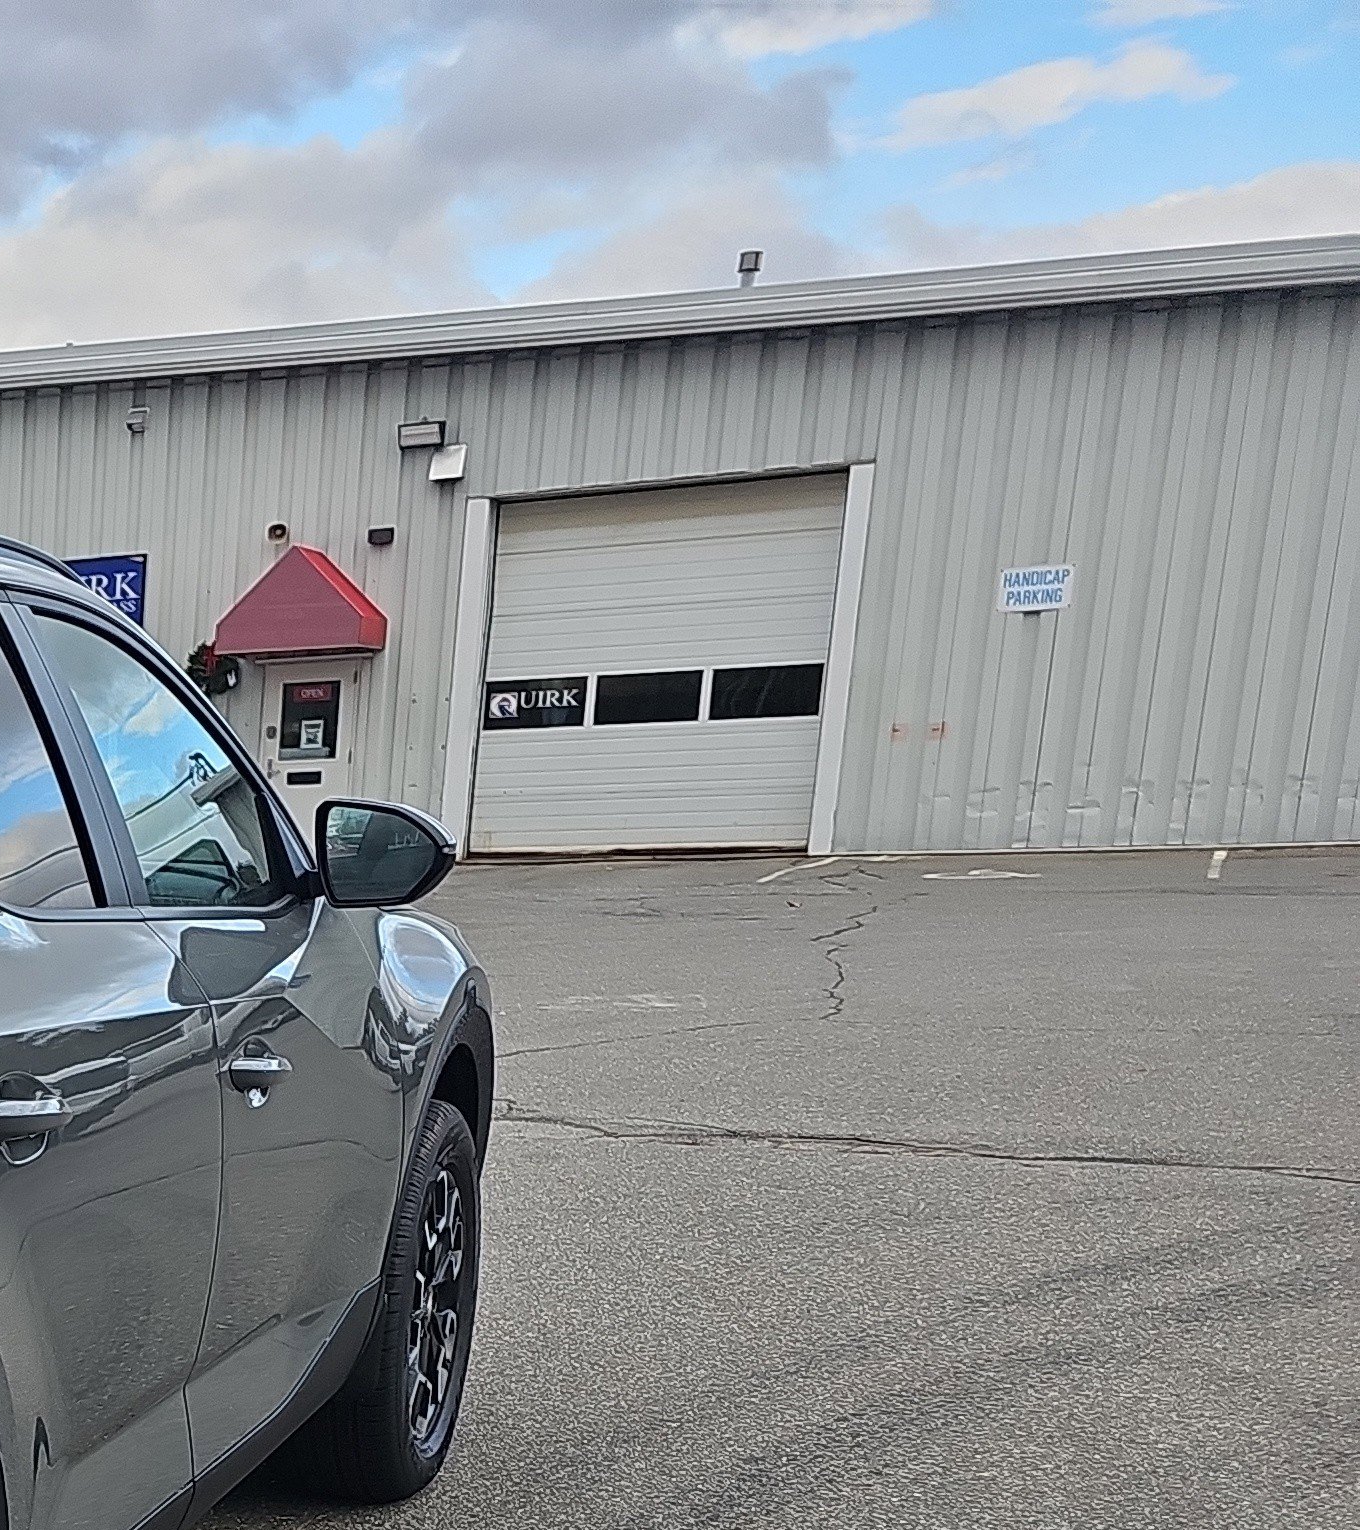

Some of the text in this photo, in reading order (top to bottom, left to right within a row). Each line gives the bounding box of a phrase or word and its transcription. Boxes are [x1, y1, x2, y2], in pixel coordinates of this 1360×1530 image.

[1002, 568, 1071, 588] HANDICAP
[1005, 587, 1064, 606] PARKING
[488, 688, 580, 718] QUIRK
